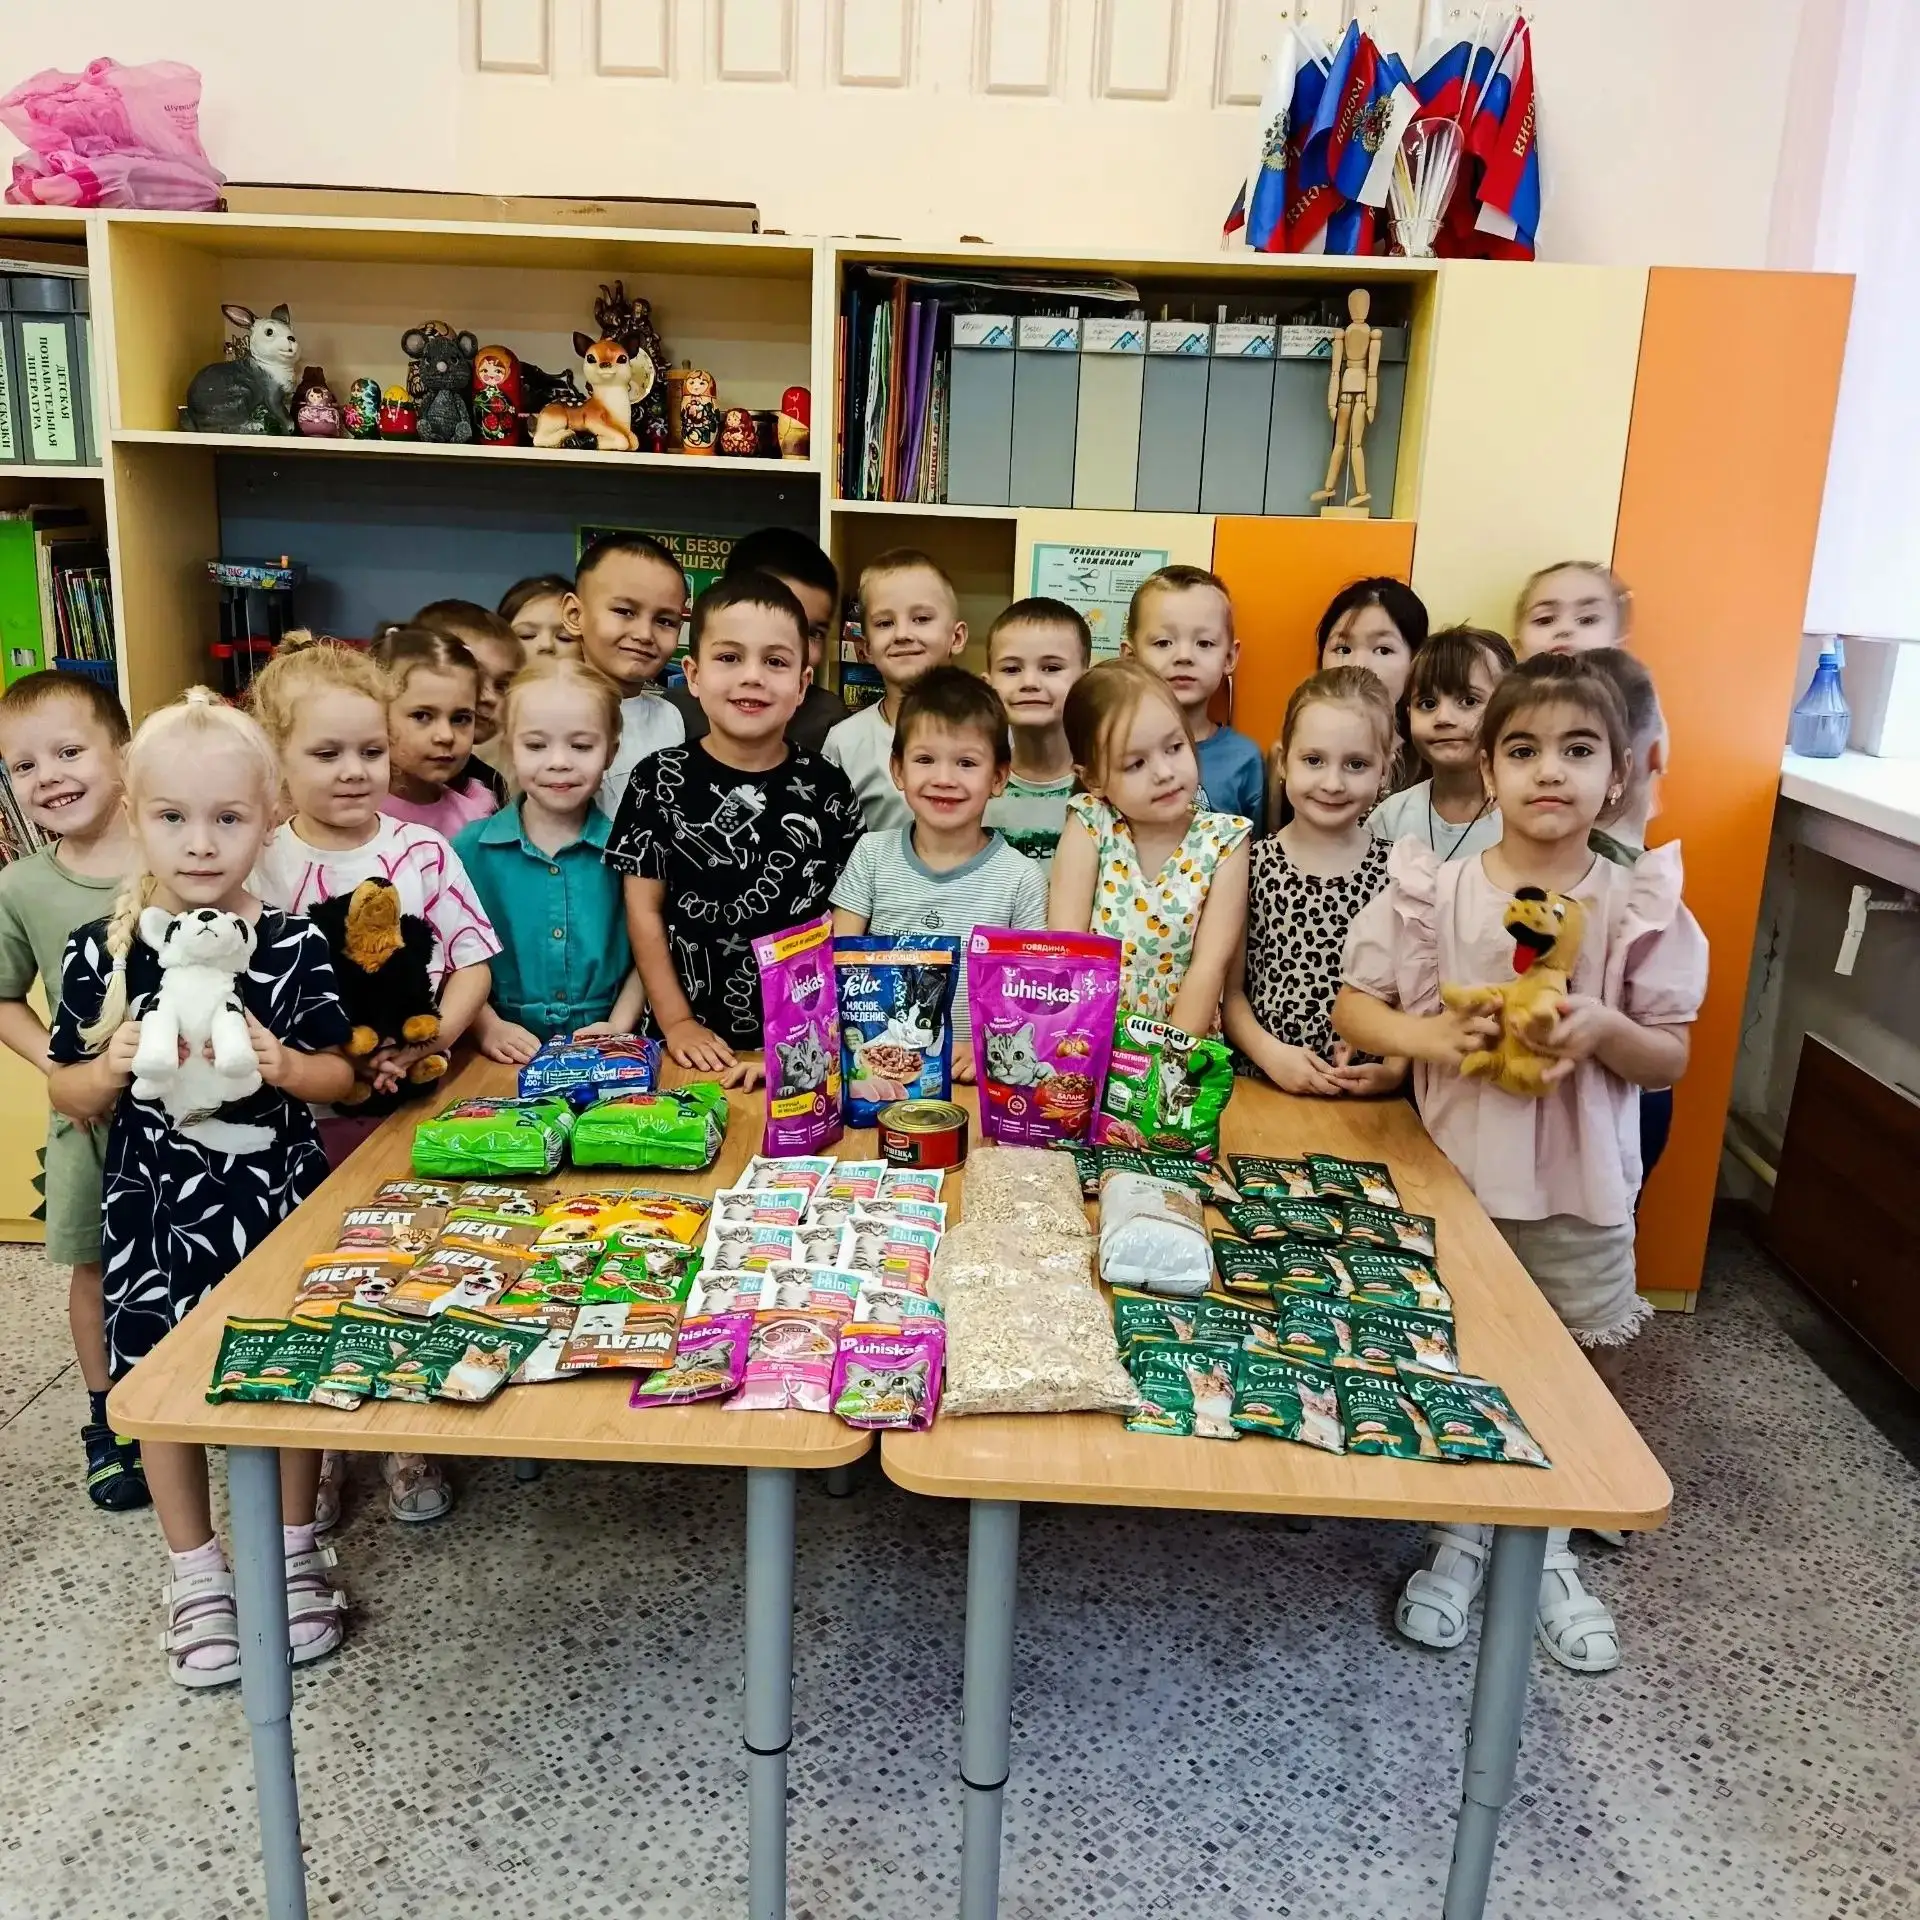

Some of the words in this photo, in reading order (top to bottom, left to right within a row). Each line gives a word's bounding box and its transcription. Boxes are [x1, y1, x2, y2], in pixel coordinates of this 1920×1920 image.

[1337, 77, 1365, 144] РОССИЯ
[27, 353, 41, 430] ЛИТЕРАТУРА
[39, 337, 57, 447] ПОЗНАВАТЕЛЬНАЯ
[56, 363, 70, 419] ДЕТСКАЯ
[1069, 548, 1107, 557] ПРАВИЛА
[1108, 550, 1142, 558] РАБОТЫ
[1080, 557, 1134, 567] НОЖНИЦАМИ
[975, 939, 985, 948] 1+
[1001, 978, 1080, 1003] whiskas
[846, 1001, 879, 1011] МЯСНОЕ
[842, 1012, 885, 1022] ОБЪЕДЕНИЕ
[381, 1183, 449, 1195] MEAT
[460, 1186, 527, 1198] MEAT
[344, 1211, 416, 1227] MEAT
[442, 1221, 512, 1239] MEAT
[428, 1249, 501, 1270] MEAT
[303, 1266, 381, 1287] MEAT
[817, 1278, 852, 1291] PRIDE
[1122, 1317, 1167, 1326] ADULT
[1201, 1323, 1248, 1331] ADULT
[594, 1332, 673, 1350] MEAT
[1358, 1326, 1404, 1341] ADULT
[335, 1336, 387, 1347] ADULT
[1245, 1381, 1295, 1391] ADULT
[1347, 1390, 1395, 1405] ADULT
[1426, 1396, 1472, 1411] ADULT
